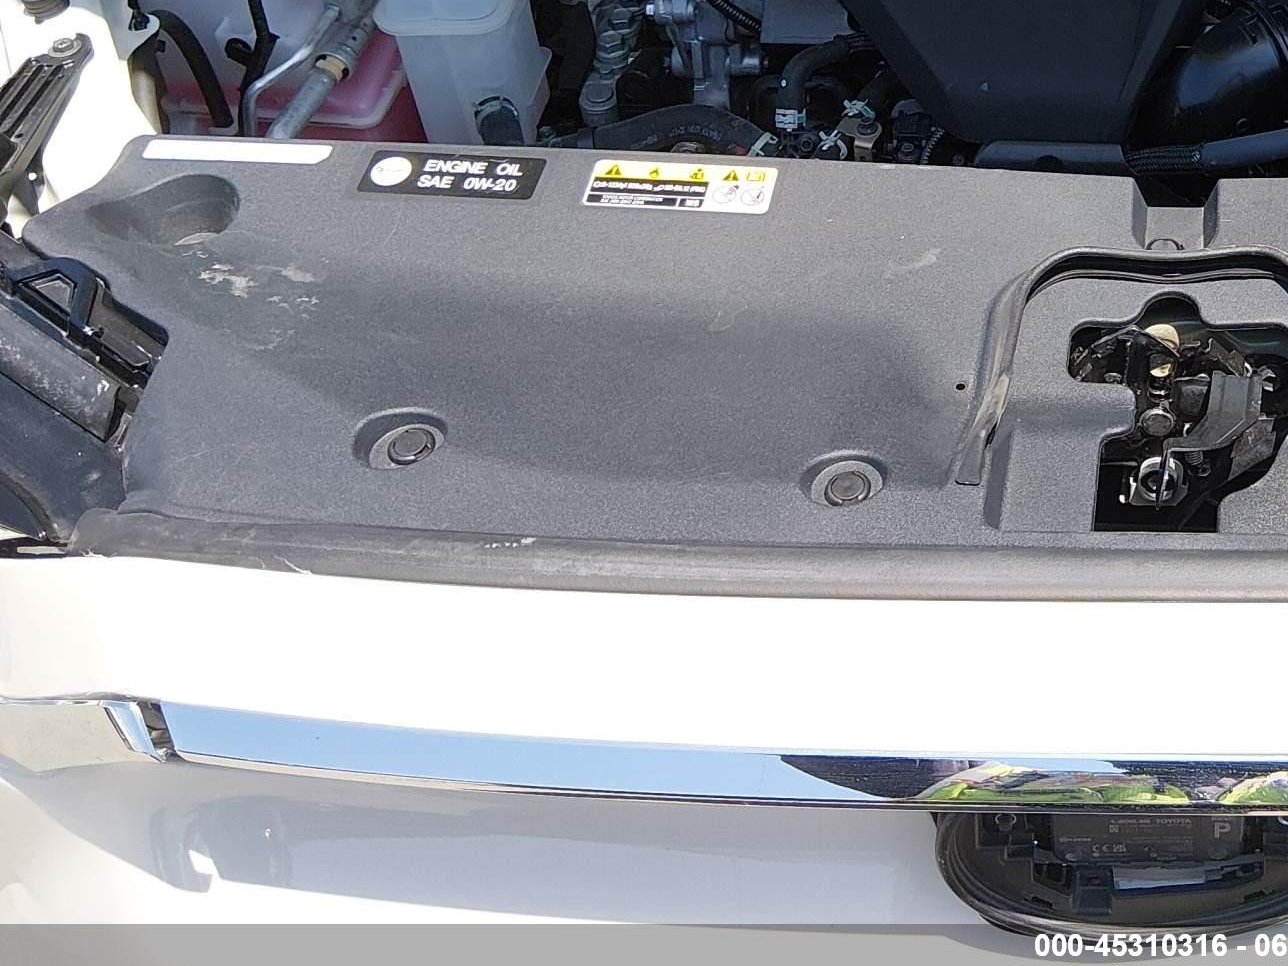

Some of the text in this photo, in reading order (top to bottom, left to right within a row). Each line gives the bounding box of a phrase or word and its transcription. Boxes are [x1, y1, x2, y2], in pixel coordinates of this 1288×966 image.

[423, 159, 523, 176] ENGINE OIL
[417, 174, 518, 192] SAE 0W-20
